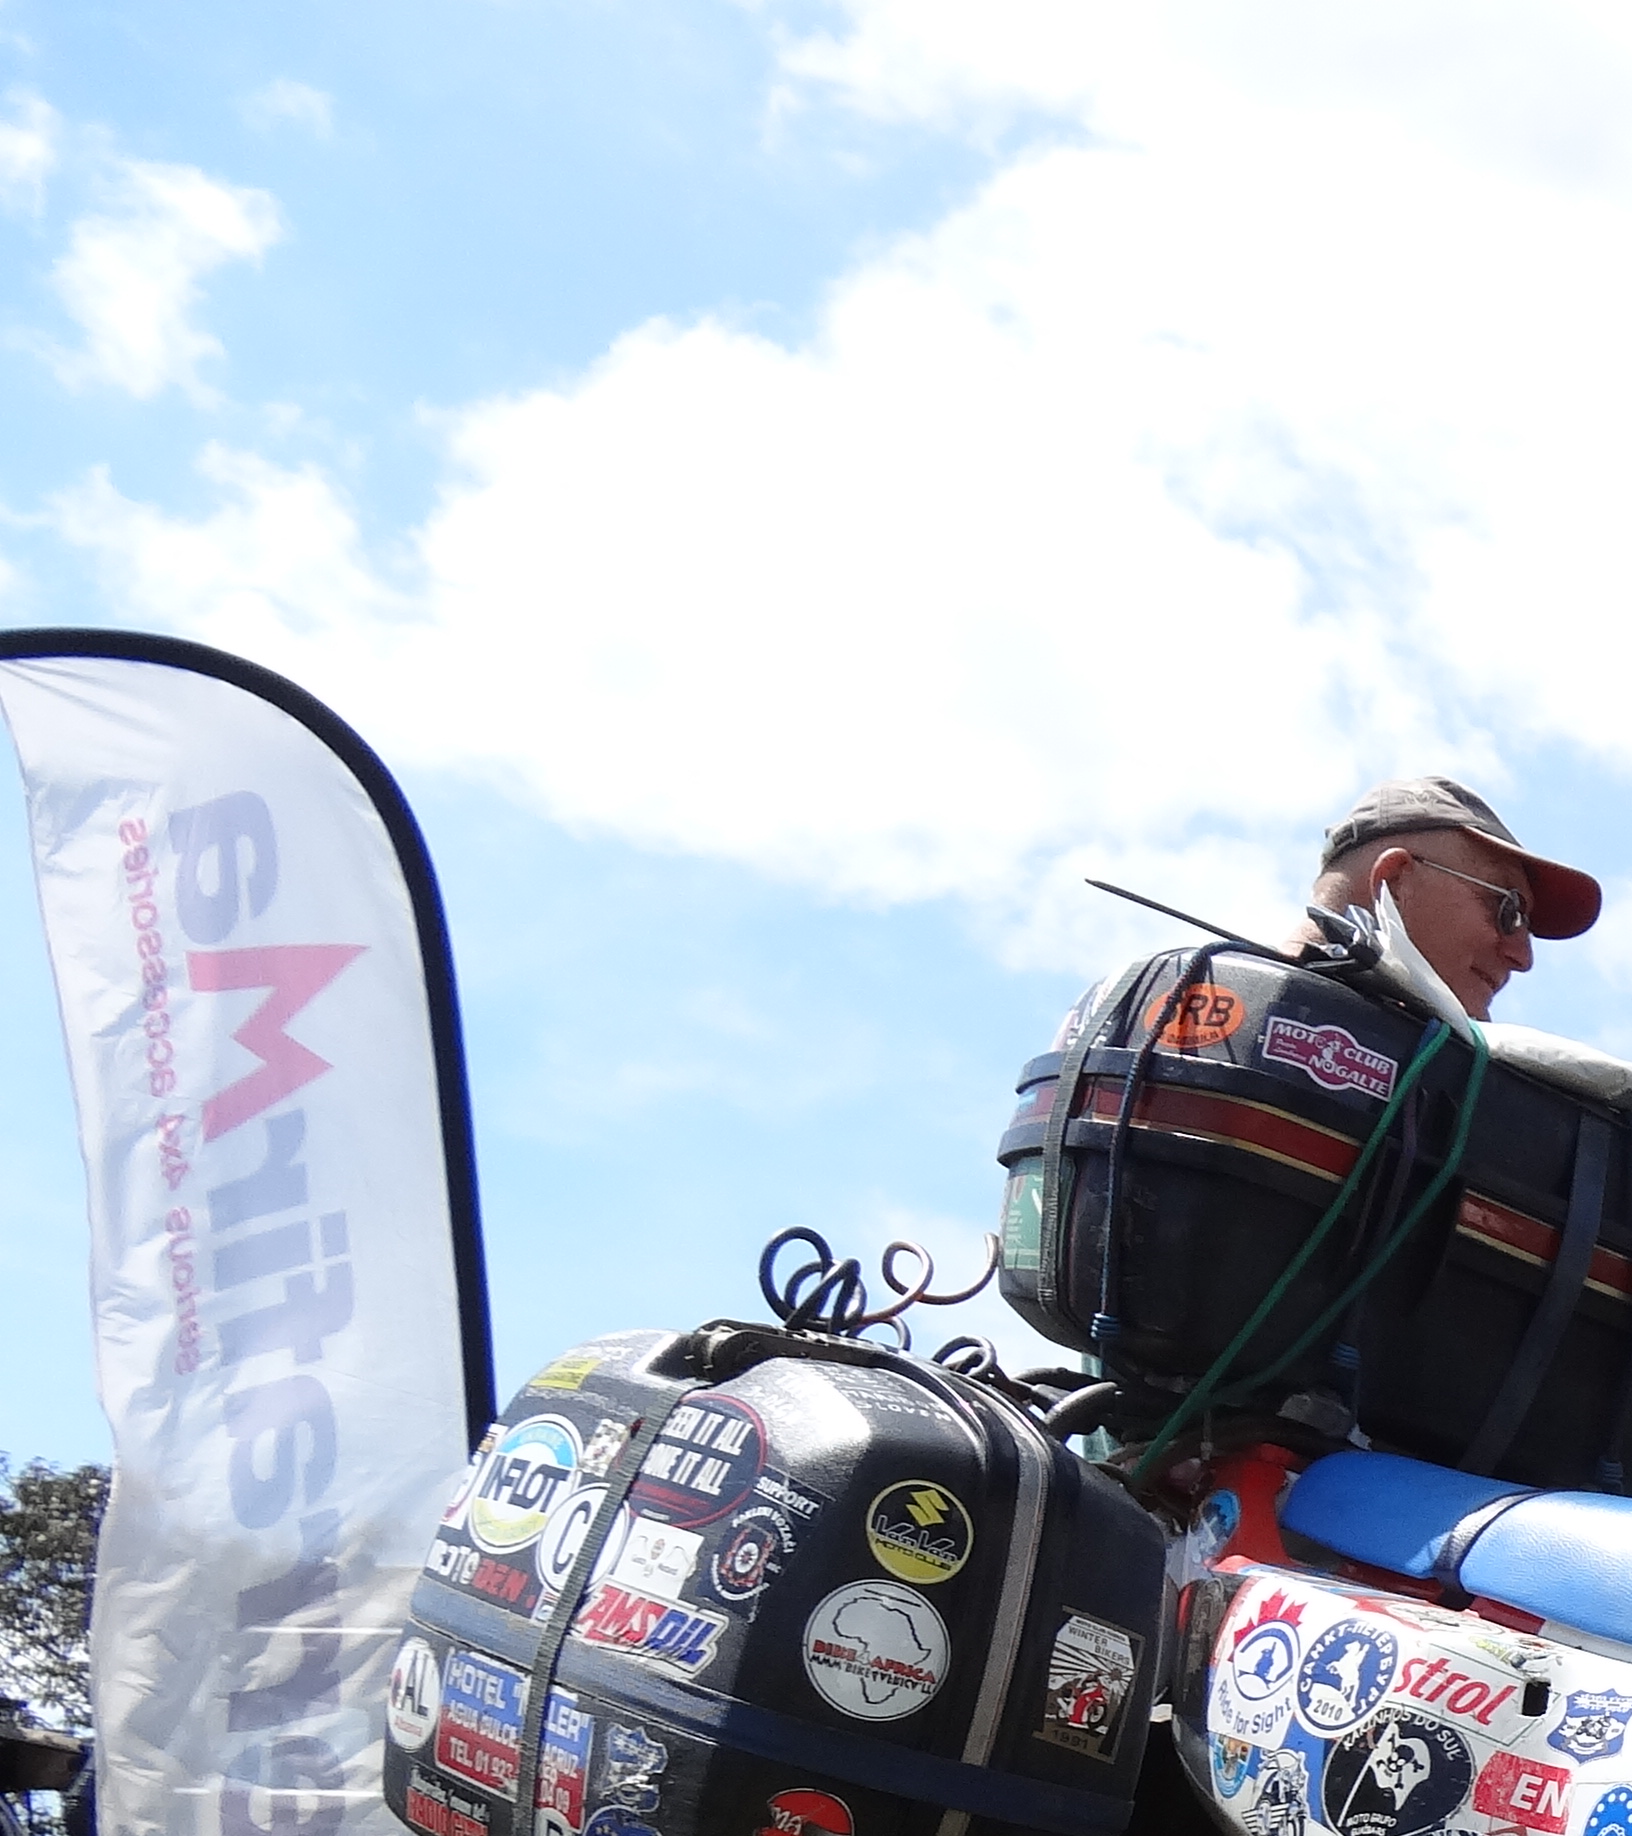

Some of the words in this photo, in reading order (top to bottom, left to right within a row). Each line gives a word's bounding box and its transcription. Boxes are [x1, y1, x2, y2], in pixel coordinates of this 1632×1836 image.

[1308, 1054, 1389, 1096] NOGALTE
[1343, 1047, 1390, 1075] CLUB
[711, 1418, 754, 1456] ALL
[690, 1457, 732, 1496] ALL
[754, 1475, 820, 1515] SUPPORT
[1068, 1625, 1108, 1646] WINTER
[1094, 1644, 1130, 1666] BIKERS
[447, 1657, 506, 1709] HOTEL
[1392, 1657, 1518, 1727] strol
[1233, 1710, 1250, 1735] for
[1251, 1696, 1292, 1735] Sight
[1313, 1698, 1343, 1722] 2010
[1413, 1714, 1438, 1732] DO
[1436, 1726, 1464, 1760] SUL
